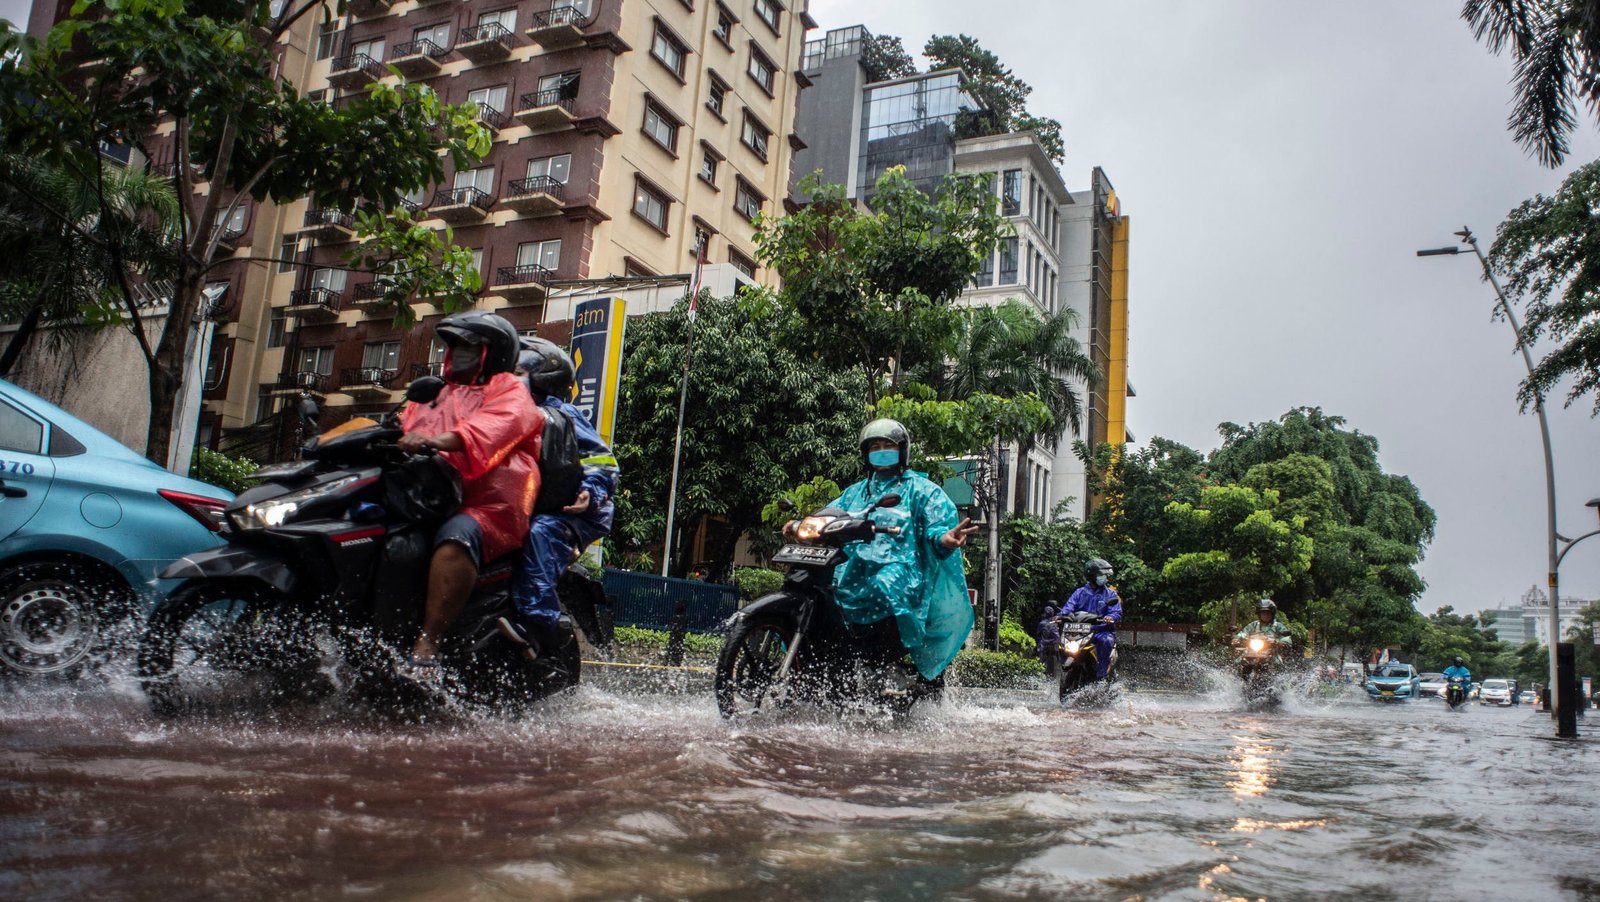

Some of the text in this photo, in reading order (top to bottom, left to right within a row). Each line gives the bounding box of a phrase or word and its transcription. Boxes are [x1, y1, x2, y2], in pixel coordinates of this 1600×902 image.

[576, 308, 605, 328] atm
[575, 377, 597, 422] diri
[340, 536, 374, 547] HONDA
